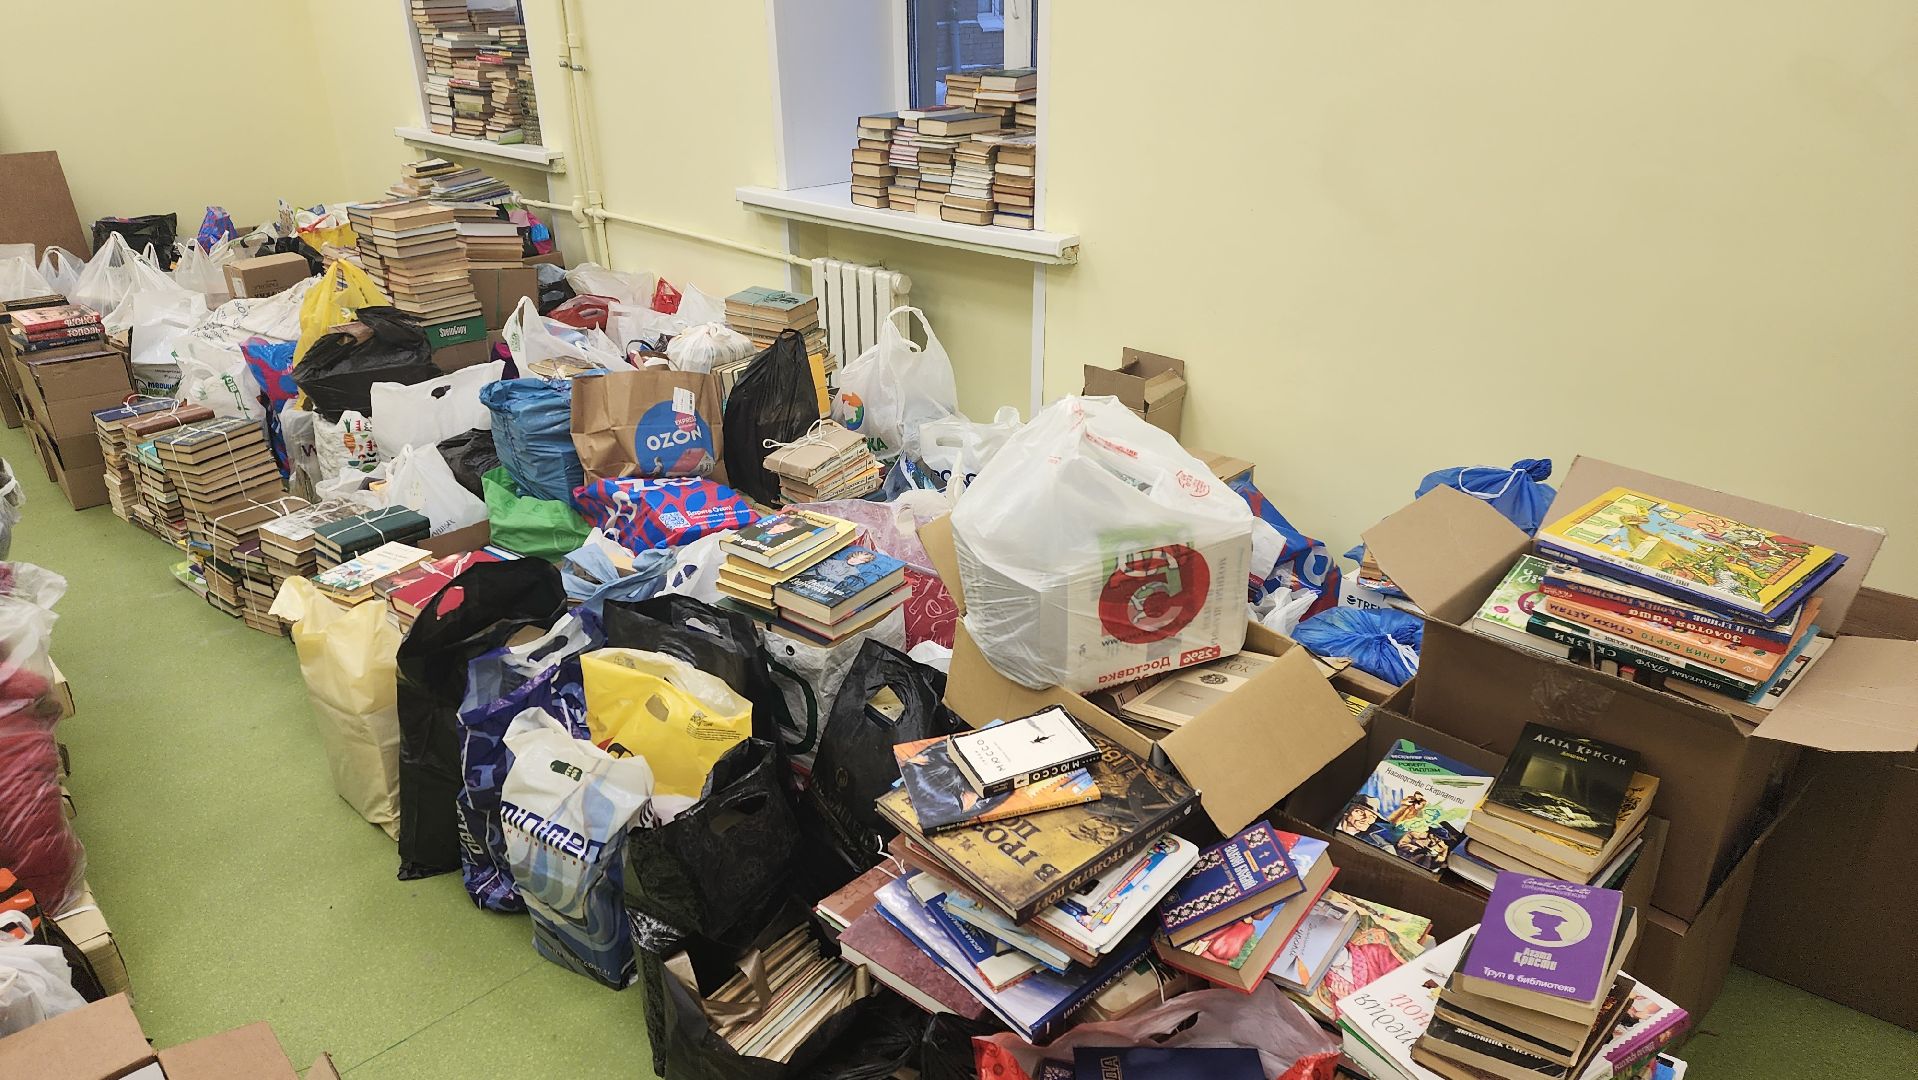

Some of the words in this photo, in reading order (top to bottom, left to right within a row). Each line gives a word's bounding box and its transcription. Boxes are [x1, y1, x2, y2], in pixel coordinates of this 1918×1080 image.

[646, 425, 702, 451] OZON
[1357, 598, 1381, 610] TRE
[1549, 603, 1590, 619] ДЕТЯМ
[1593, 617, 1634, 635] СТИХИ
[1554, 632, 1617, 658] СКАЗКИ
[1641, 632, 1681, 650] БАРТО
[1685, 646, 1727, 665] АГНИЯ
[1671, 669, 1721, 690] ВИЛЬГЕЛЬМ
[1533, 734, 1569, 750] АГАТА
[1576, 745, 1627, 766] КРИСТИ
[1032, 760, 1081, 782] МЮССО
[1385, 767, 1425, 789] Наследство
[1424, 784, 1465, 805] Скарлатти
[1033, 862, 1062, 883] В
[1068, 848, 1126, 889] ГРОЗНУЮ
[1033, 887, 1066, 916] ПОРУ
[1513, 952, 1559, 972] Кристи
[1523, 947, 1554, 962] Агата
[1483, 966, 1507, 980] Труп
[1507, 973, 1515, 981] в
[1516, 974, 1577, 994] библиотеке
[1063, 977, 1113, 1020] ЖУКОВСКИЙ
